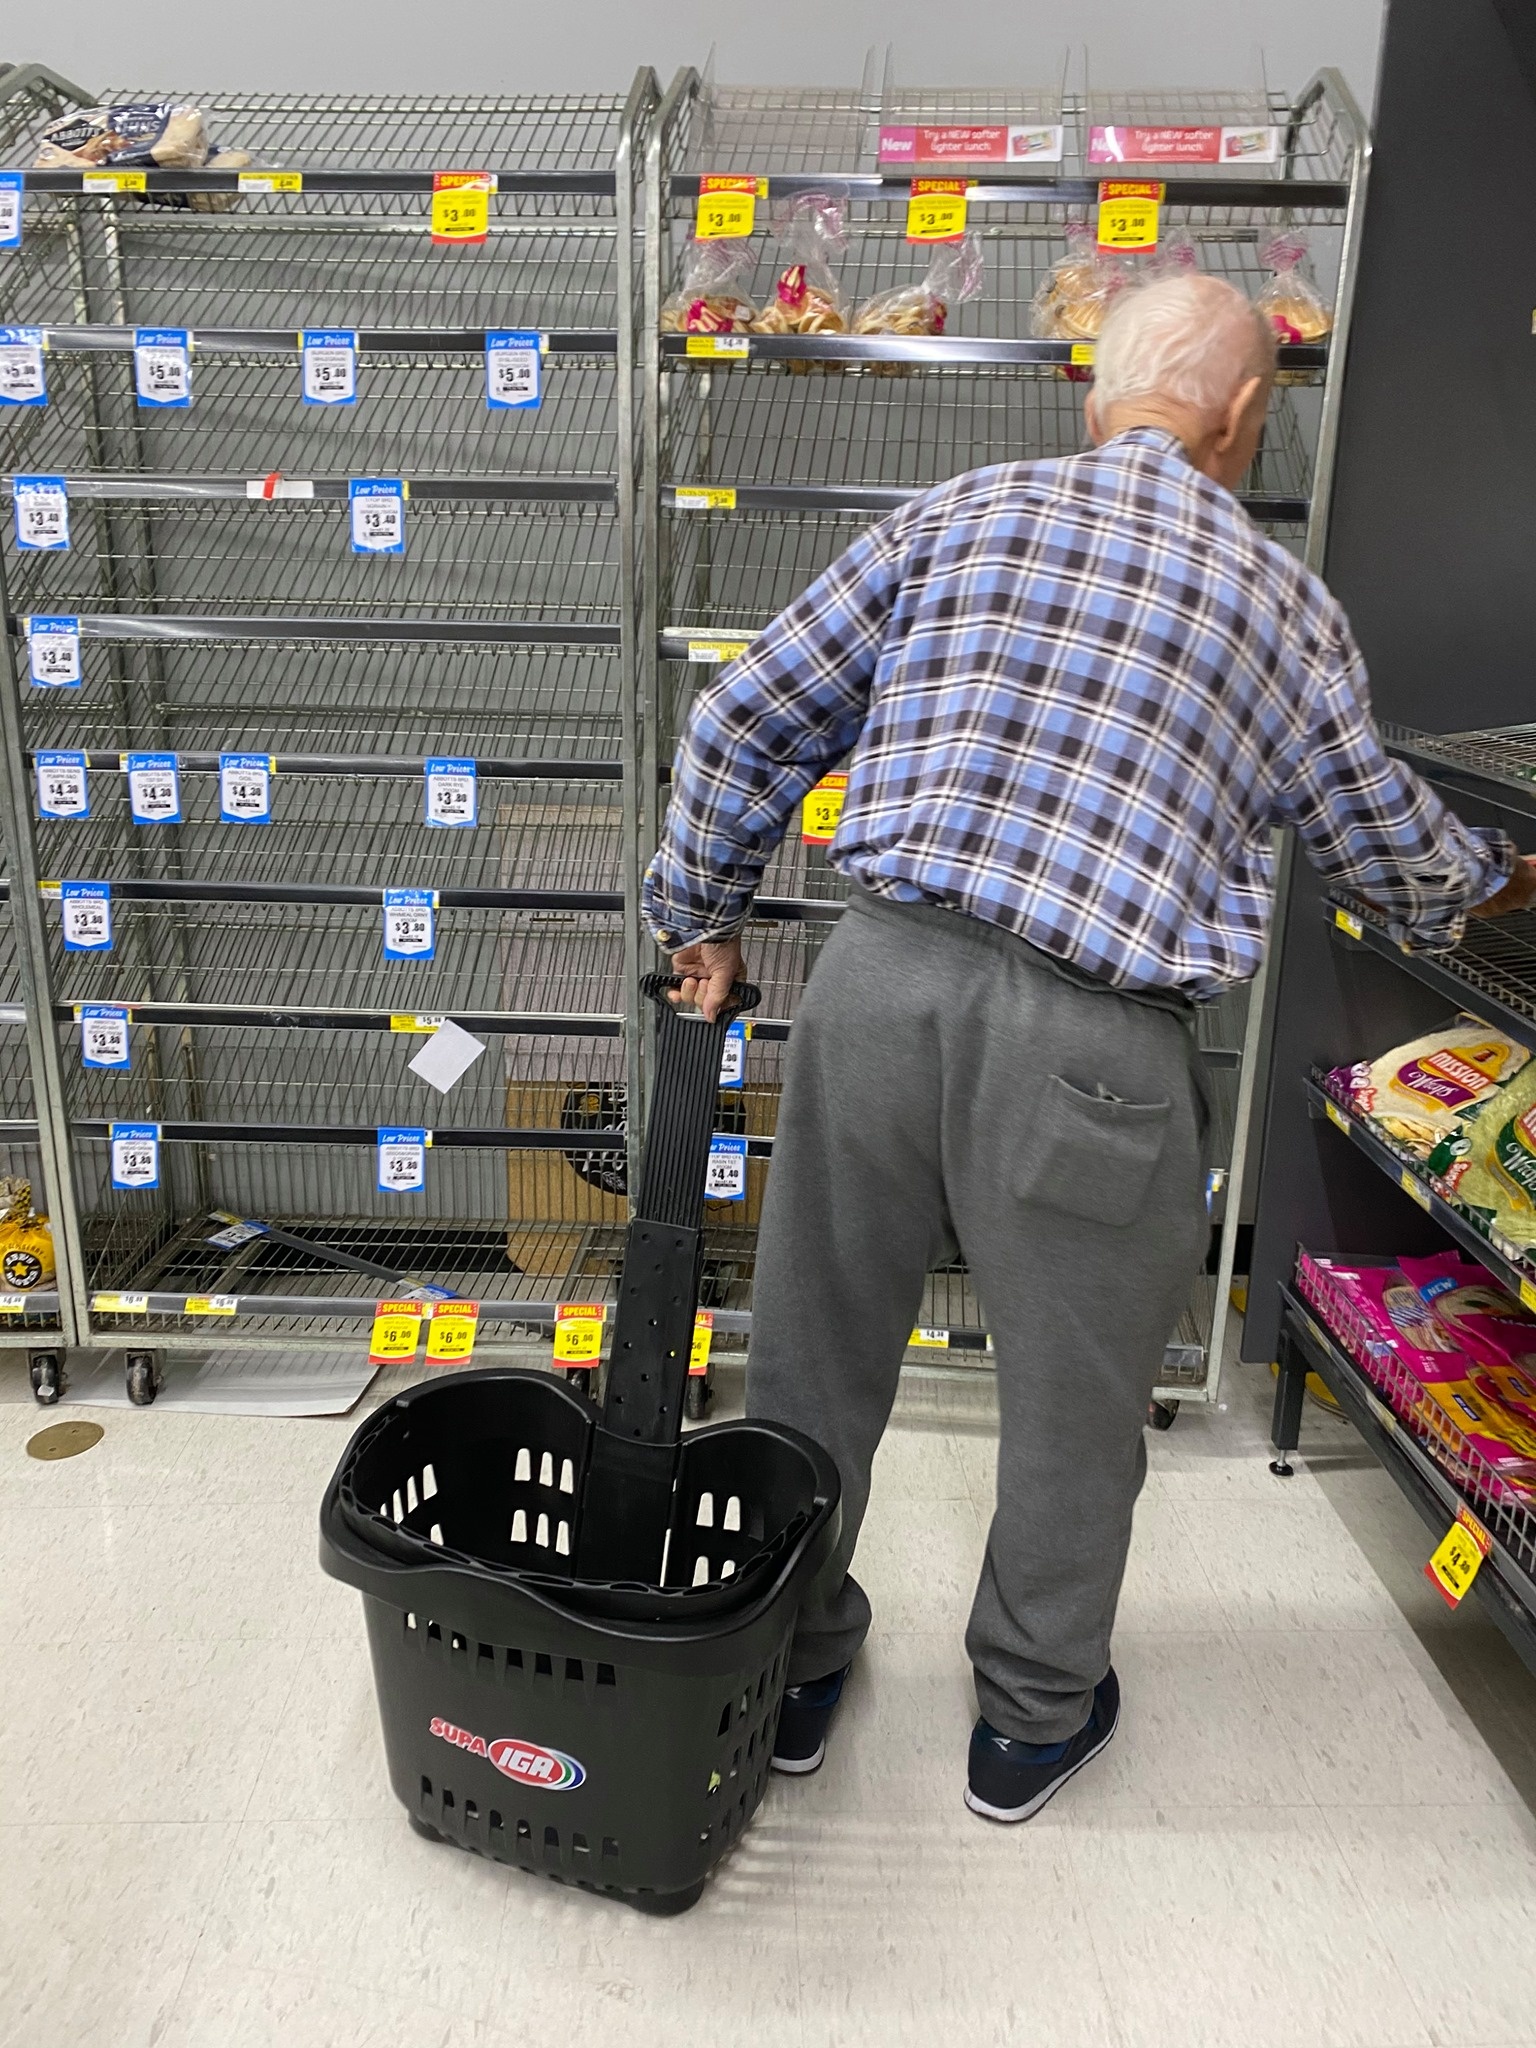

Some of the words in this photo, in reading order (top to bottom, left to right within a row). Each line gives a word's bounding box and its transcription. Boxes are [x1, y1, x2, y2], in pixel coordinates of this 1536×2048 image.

[923, 129, 939, 141] Try
[941, 131, 948, 139] a
[948, 130, 971, 139] NEW
[972, 129, 1001, 139] softer
[1135, 130, 1150, 142] Try
[1184, 130, 1213, 139] softer
[881, 138, 912, 151] New
[931, 141, 962, 154] lighter
[964, 141, 991, 151] lunch
[1141, 142, 1174, 154] lighter
[1176, 142, 1204, 152] lunch
[707, 177, 750, 189] SPECIAL
[917, 180, 961, 192] SPECIAL
[1107, 183, 1153, 195] SPECIAL
[139, 333, 153, 344] Low
[156, 332, 183, 345] Prices
[306, 335, 324, 346] Low
[325, 334, 351, 346] Prices
[491, 337, 508, 348] Low
[508, 336, 535, 348] Prices
[355, 485, 370, 495] Low
[372, 483, 398, 495] Prices
[39, 755, 55, 765] Low
[56, 754, 80, 765] Prices
[131, 760, 147, 770] Low
[148, 759, 171, 770] Prices
[431, 763, 445, 773] Low
[446, 763, 471, 773] Prices
[65, 888, 81, 897] Low
[81, 887, 105, 898] Prices
[84, 1007, 100, 1017] Low
[99, 1006, 124, 1018] Prices
[1407, 1071, 1460, 1097] Wraps
[114, 1130, 130, 1139] Low
[130, 1129, 154, 1140] Prices
[381, 1134, 397, 1143] Low
[397, 1132, 421, 1144] Prices
[718, 1141, 742, 1152] Prices
[711, 1168, 739, 1181] $4.40
[1428, 1278, 1454, 1298] NEW
[382, 1302, 418, 1313] SPECIAL
[438, 1303, 473, 1314] SPECIAL
[562, 1305, 598, 1317] SPECIAL
[1460, 1508, 1487, 1546] SPECIAL
[428, 1716, 488, 1759] SUPA
[497, 1746, 556, 1782] IGA
